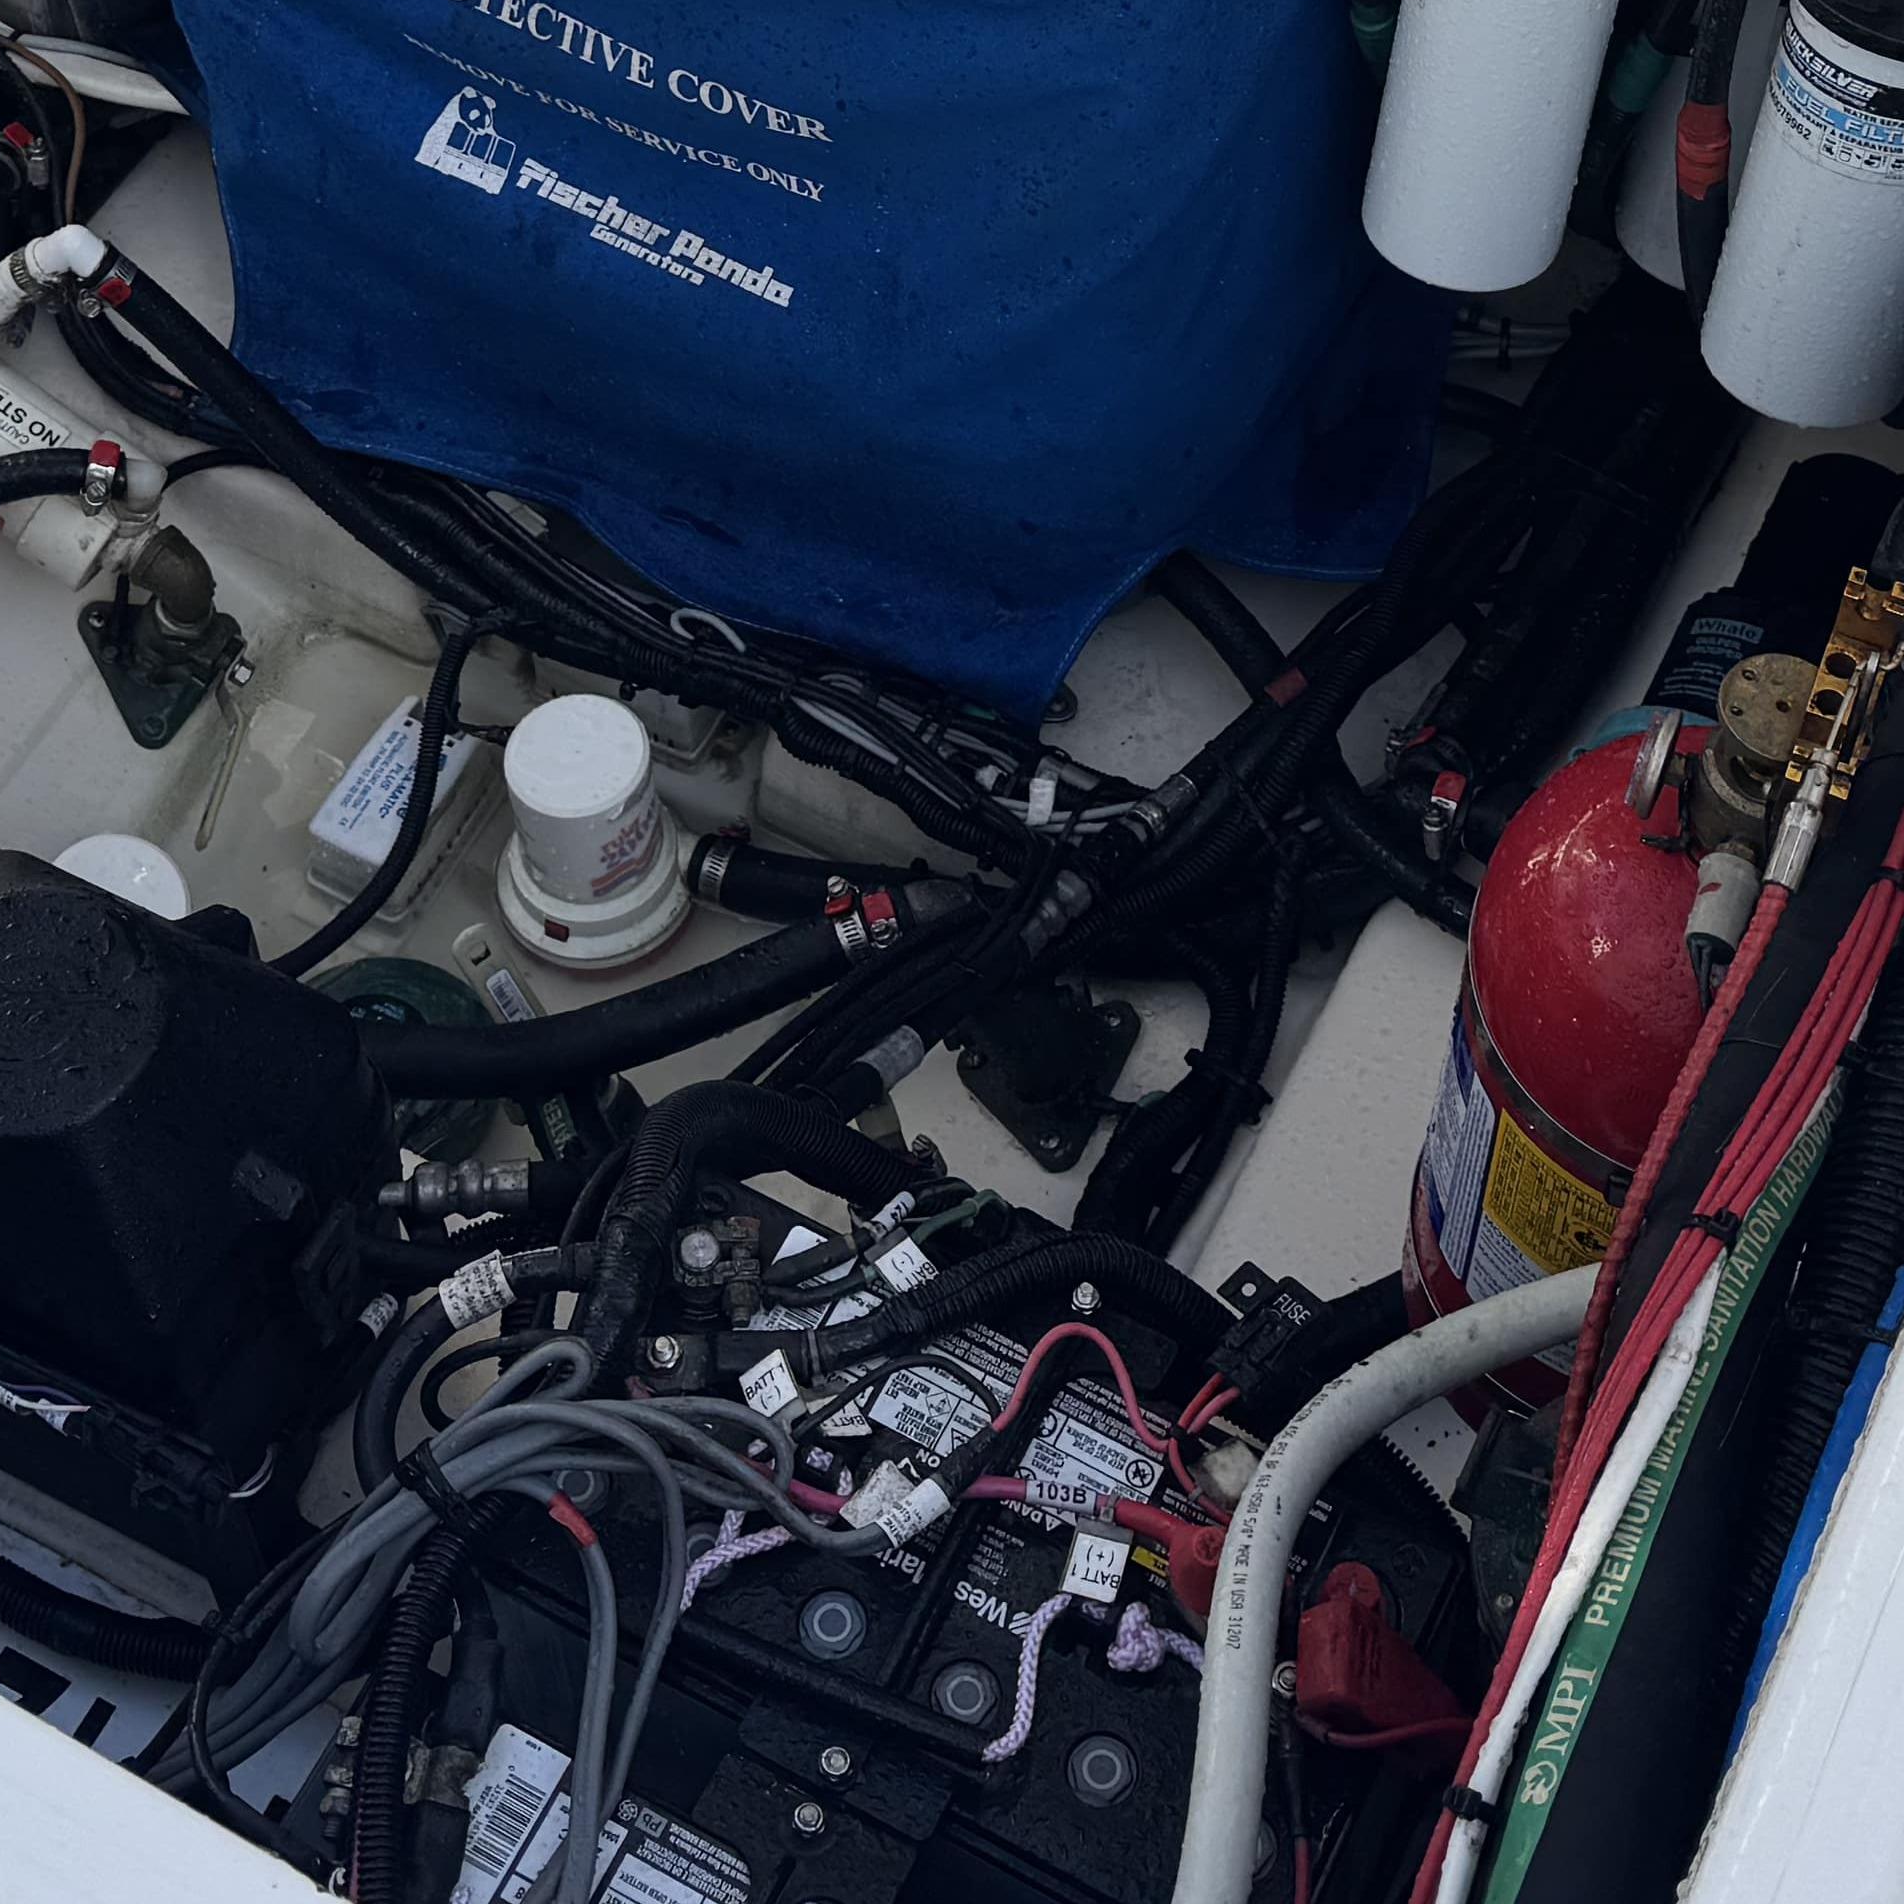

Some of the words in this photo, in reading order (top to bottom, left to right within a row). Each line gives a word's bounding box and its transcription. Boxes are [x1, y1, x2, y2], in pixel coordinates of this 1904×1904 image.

[1784, 18, 1880, 98] QUICKSILVER
[667, 68, 833, 142] COVER
[1786, 77, 1835, 125] FUEL
[537, 92, 600, 125] FOR
[607, 118, 742, 173] SERVICE
[747, 160, 825, 202] ONLY
[516, 157, 671, 247] Fischer
[673, 229, 794, 308] Panda
[590, 223, 706, 287] Generators
[28, 421, 61, 447] NO
[1698, 619, 1757, 639] Whale
[381, 761, 404, 791] PLUS
[544, 1096, 578, 1158] ATER
[1273, 1292, 1312, 1328] FUSE
[744, 1372, 777, 1401] BATT
[1584, 1470, 1662, 1628] PREMIUM
[1706, 1200, 1781, 1352] SANITATION
[1035, 1483, 1089, 1505] 103B
[1070, 1563, 1078, 1578] 1
[1235, 1544, 1252, 1568] MADE
[1081, 1569, 1121, 1590] BATT
[1233, 1572, 1250, 1587] IN
[953, 1580, 1009, 1629] Wes
[1231, 1587, 1247, 1610] USA
[1225, 1615, 1245, 1650] 31207
[1535, 1658, 1597, 1757] MPI
[638, 1811, 663, 1833] Pb
